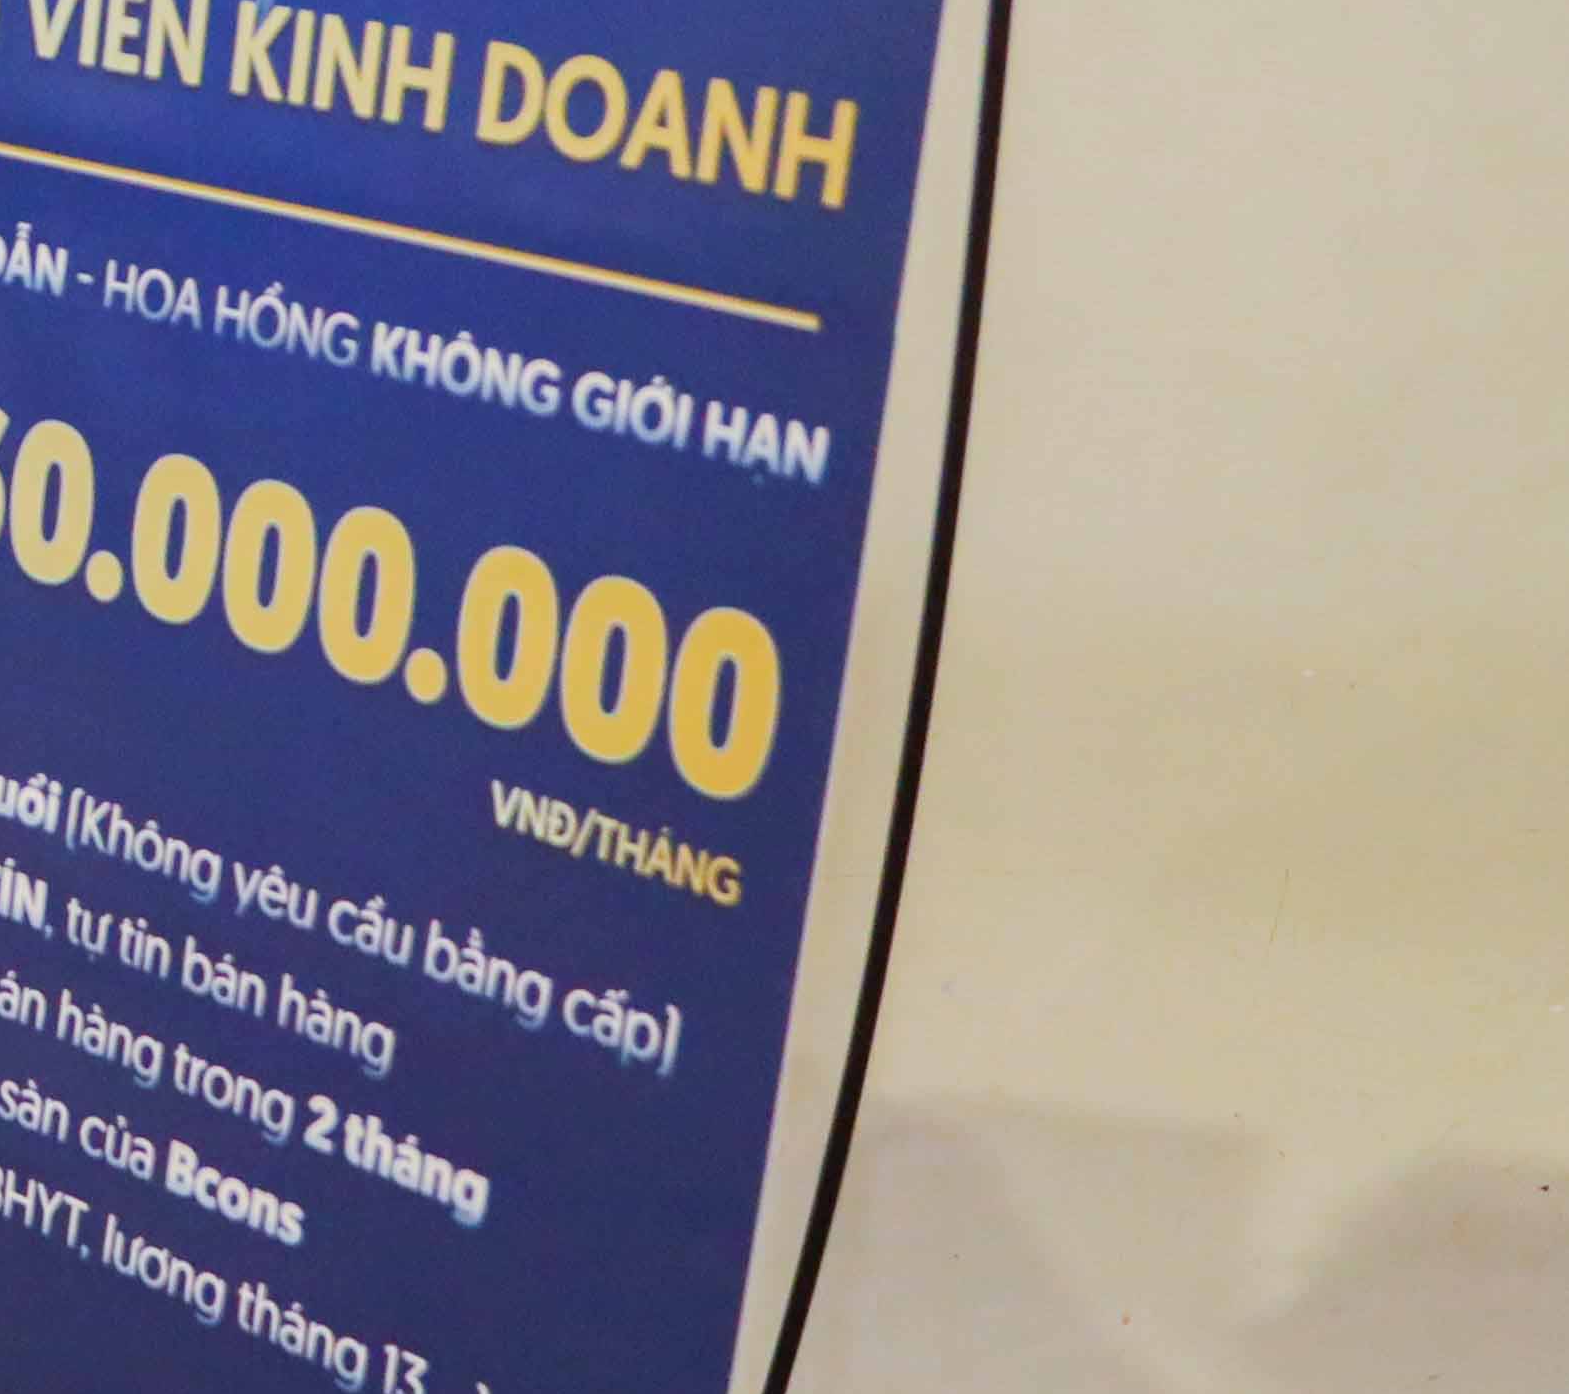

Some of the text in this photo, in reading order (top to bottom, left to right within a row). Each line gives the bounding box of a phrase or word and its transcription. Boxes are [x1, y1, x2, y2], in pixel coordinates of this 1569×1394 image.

[230, 0, 455, 138] KINH
[476, 40, 860, 212] DOANH
[77, 271, 93, 286] -
[103, 259, 203, 330] HOA
[214, 281, 361, 366] HỒNG
[370, 321, 562, 416] KHÔNG
[572, 371, 693, 450] GIỚI
[702, 401, 830, 486] HẠN
[66, 786, 222, 905] (Không
[233, 861, 318, 930] yêu
[327, 894, 415, 967] cầu
[423, 918, 553, 1030] bằng
[562, 988, 681, 1076] cấp)
[492, 777, 743, 907] VNĐ/THÁNG
